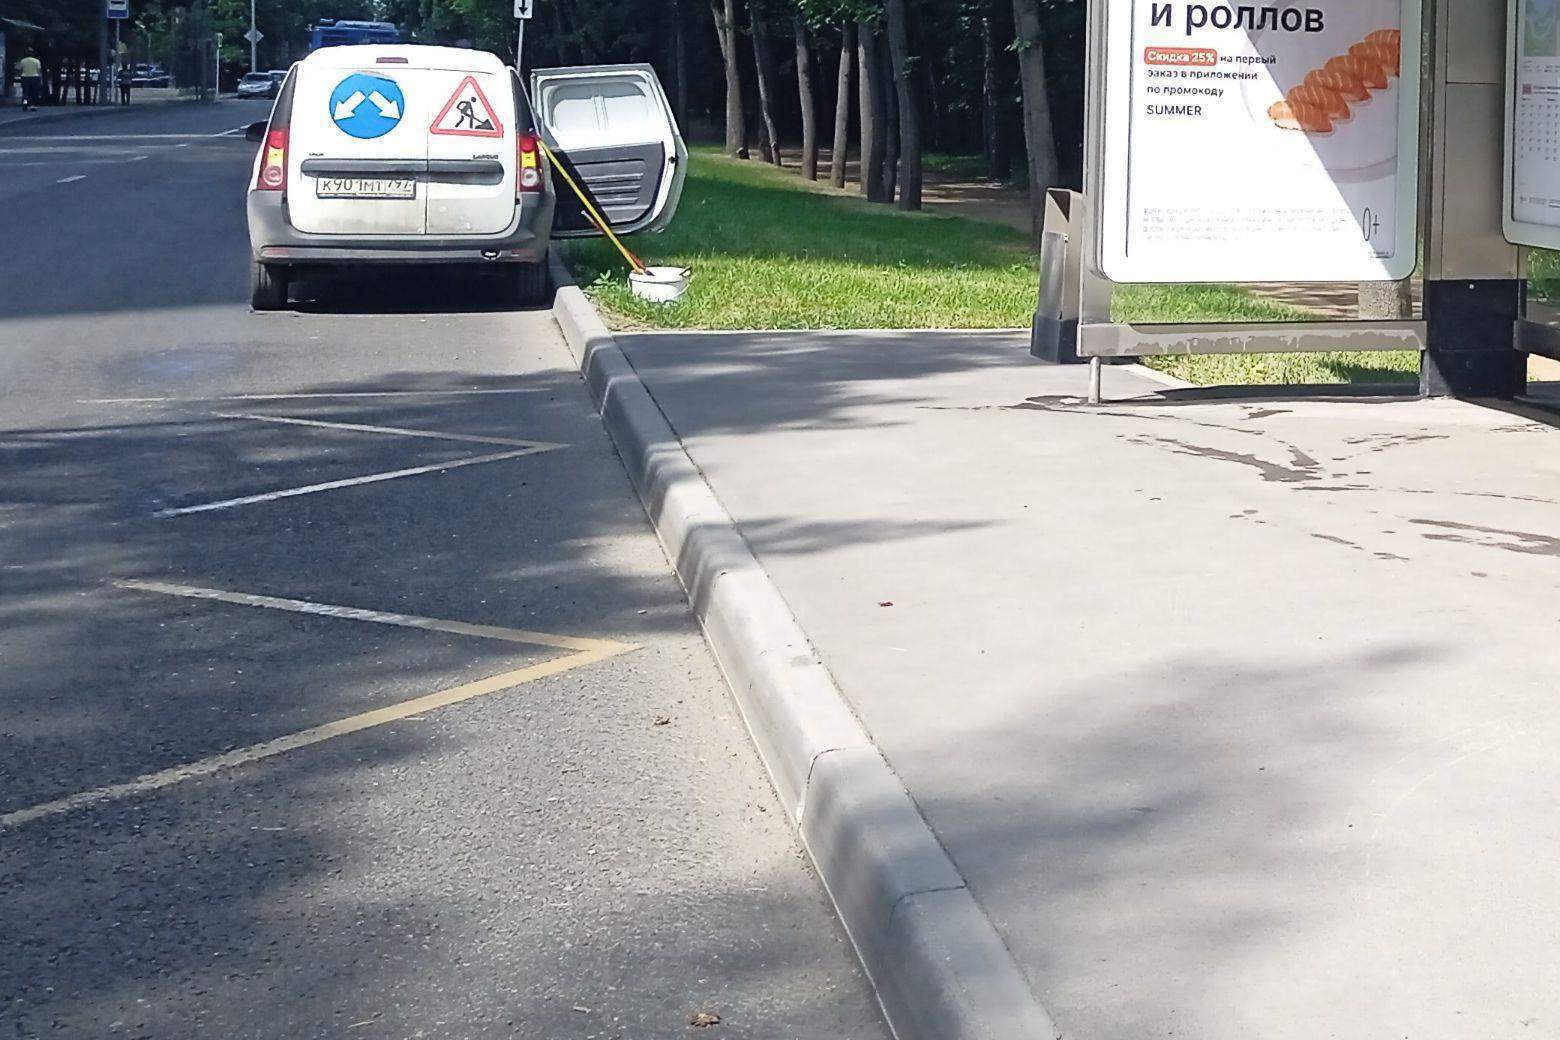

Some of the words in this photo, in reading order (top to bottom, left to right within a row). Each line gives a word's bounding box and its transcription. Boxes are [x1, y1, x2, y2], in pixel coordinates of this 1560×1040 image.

[1150, 4, 1172, 28] и
[1185, 4, 1326, 37] роллов
[1147, 50, 1190, 63] Скидка
[1192, 51, 1215, 63] 25%
[1220, 55, 1233, 63] на
[1235, 55, 1277, 66] первый
[1147, 69, 1178, 78] заказ
[1181, 70, 1187, 78] в
[1189, 70, 1259, 80] приложении
[1147, 85, 1160, 94] по
[1163, 86, 1225, 97] промокоду
[1146, 104, 1203, 116] SUMMER
[1362, 207, 1380, 242] 0+
